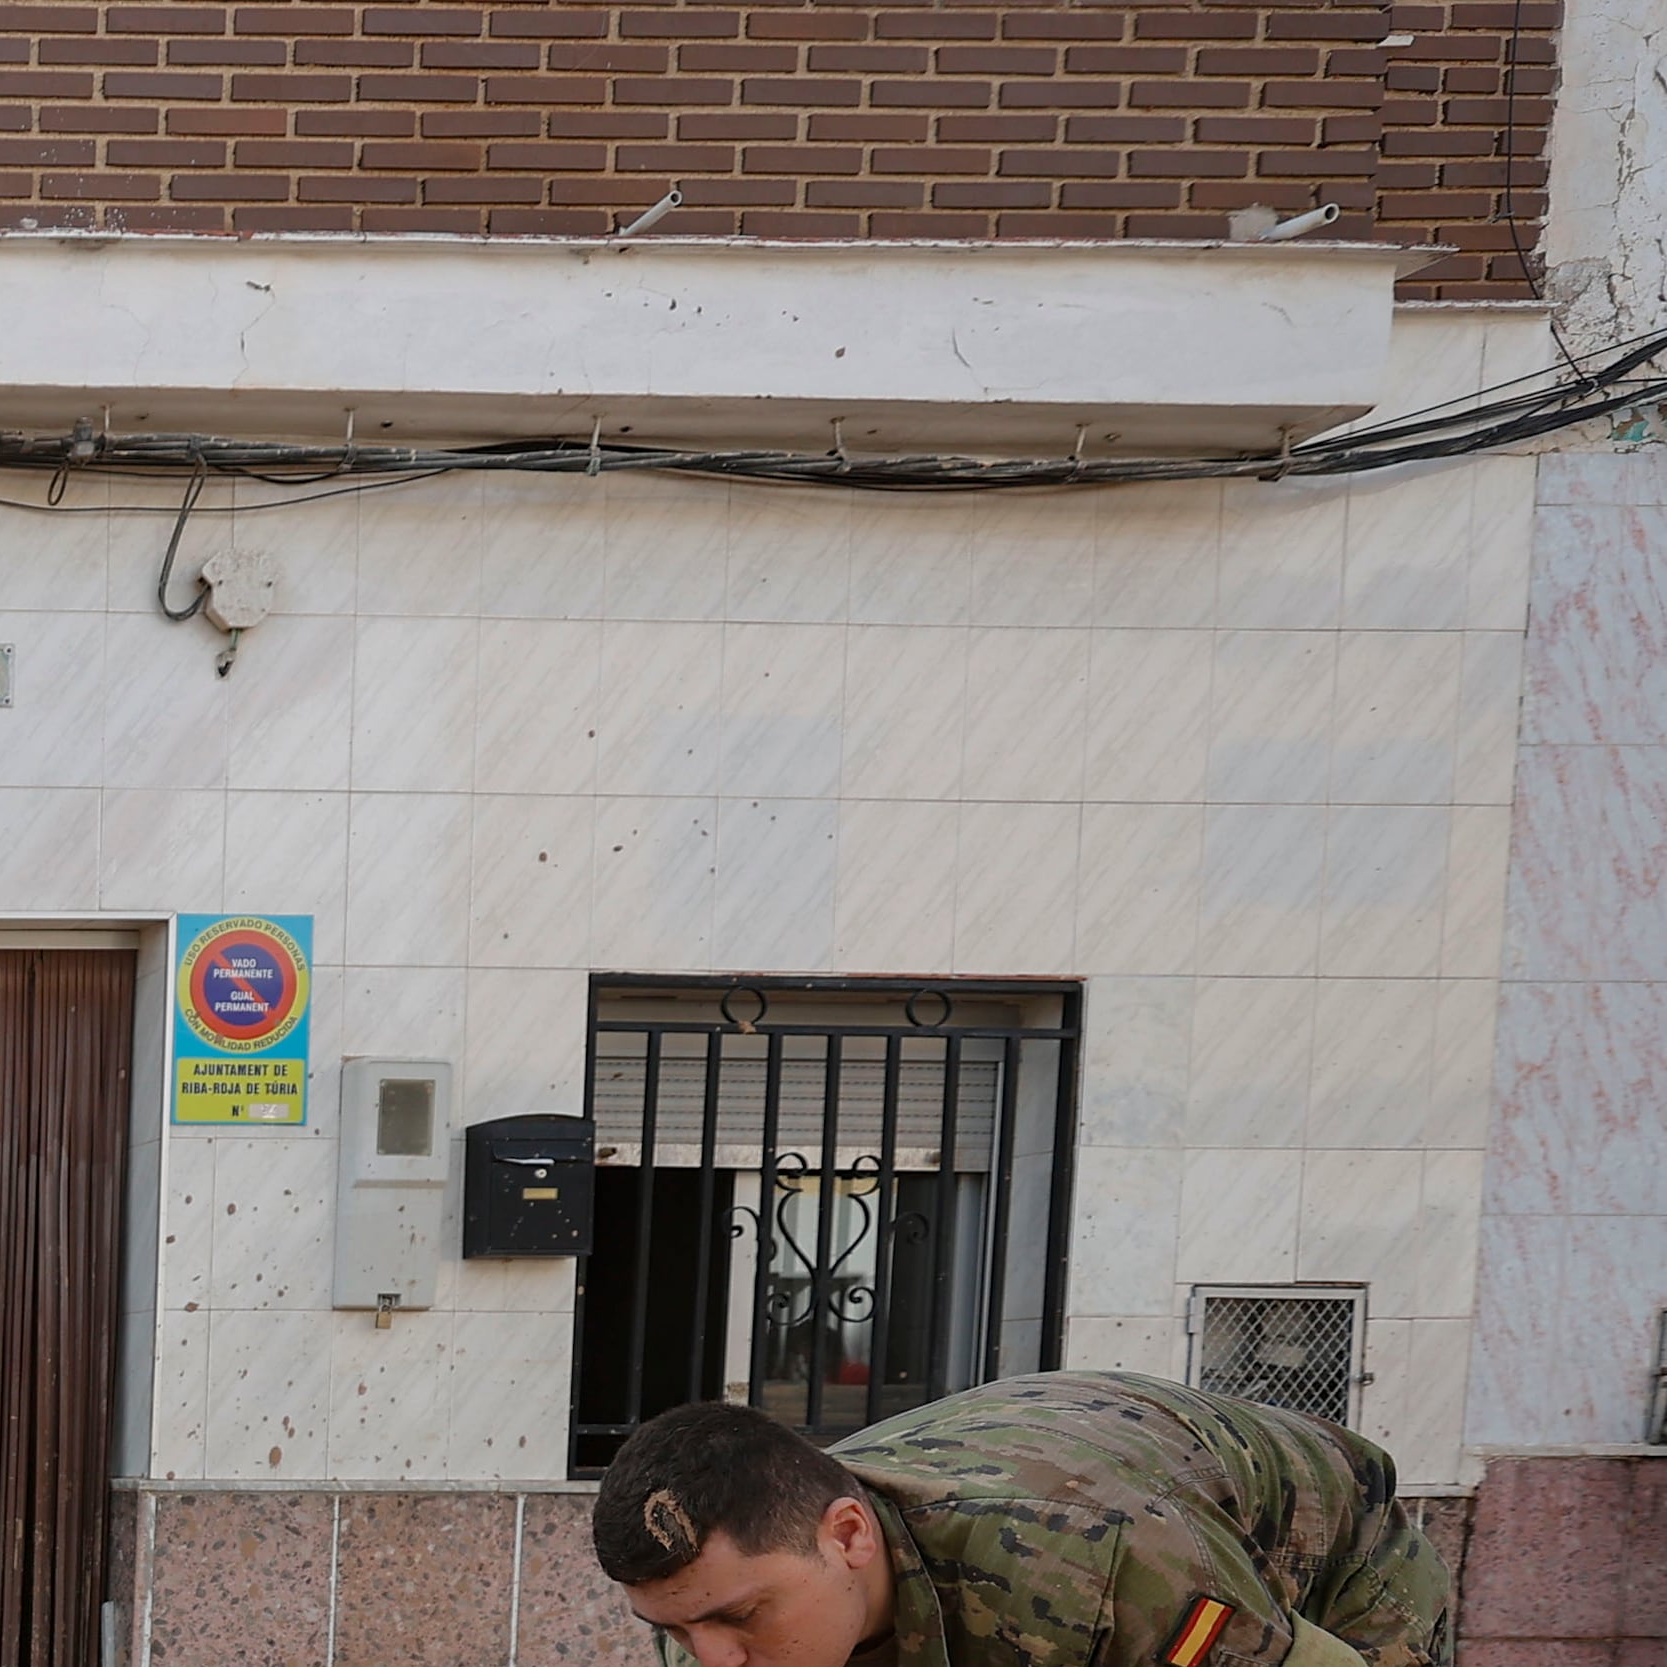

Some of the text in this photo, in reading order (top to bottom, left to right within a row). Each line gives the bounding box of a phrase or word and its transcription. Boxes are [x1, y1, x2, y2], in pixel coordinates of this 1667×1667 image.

[184, 919, 306, 972] USO RESERVADO PERSONAS
[231, 958, 257, 968] VADO
[213, 968, 274, 978] PERMANENTE
[230, 990, 255, 1001] GUAL
[215, 1001, 270, 1012] PERMANENT
[185, 1008, 200, 1030] CON
[253, 1016, 298, 1050] REDUCIDA
[193, 1063, 288, 1076] AJUNTAMENT DE
[181, 1080, 298, 1095] RIBA-ROJA DE TÚRIA
